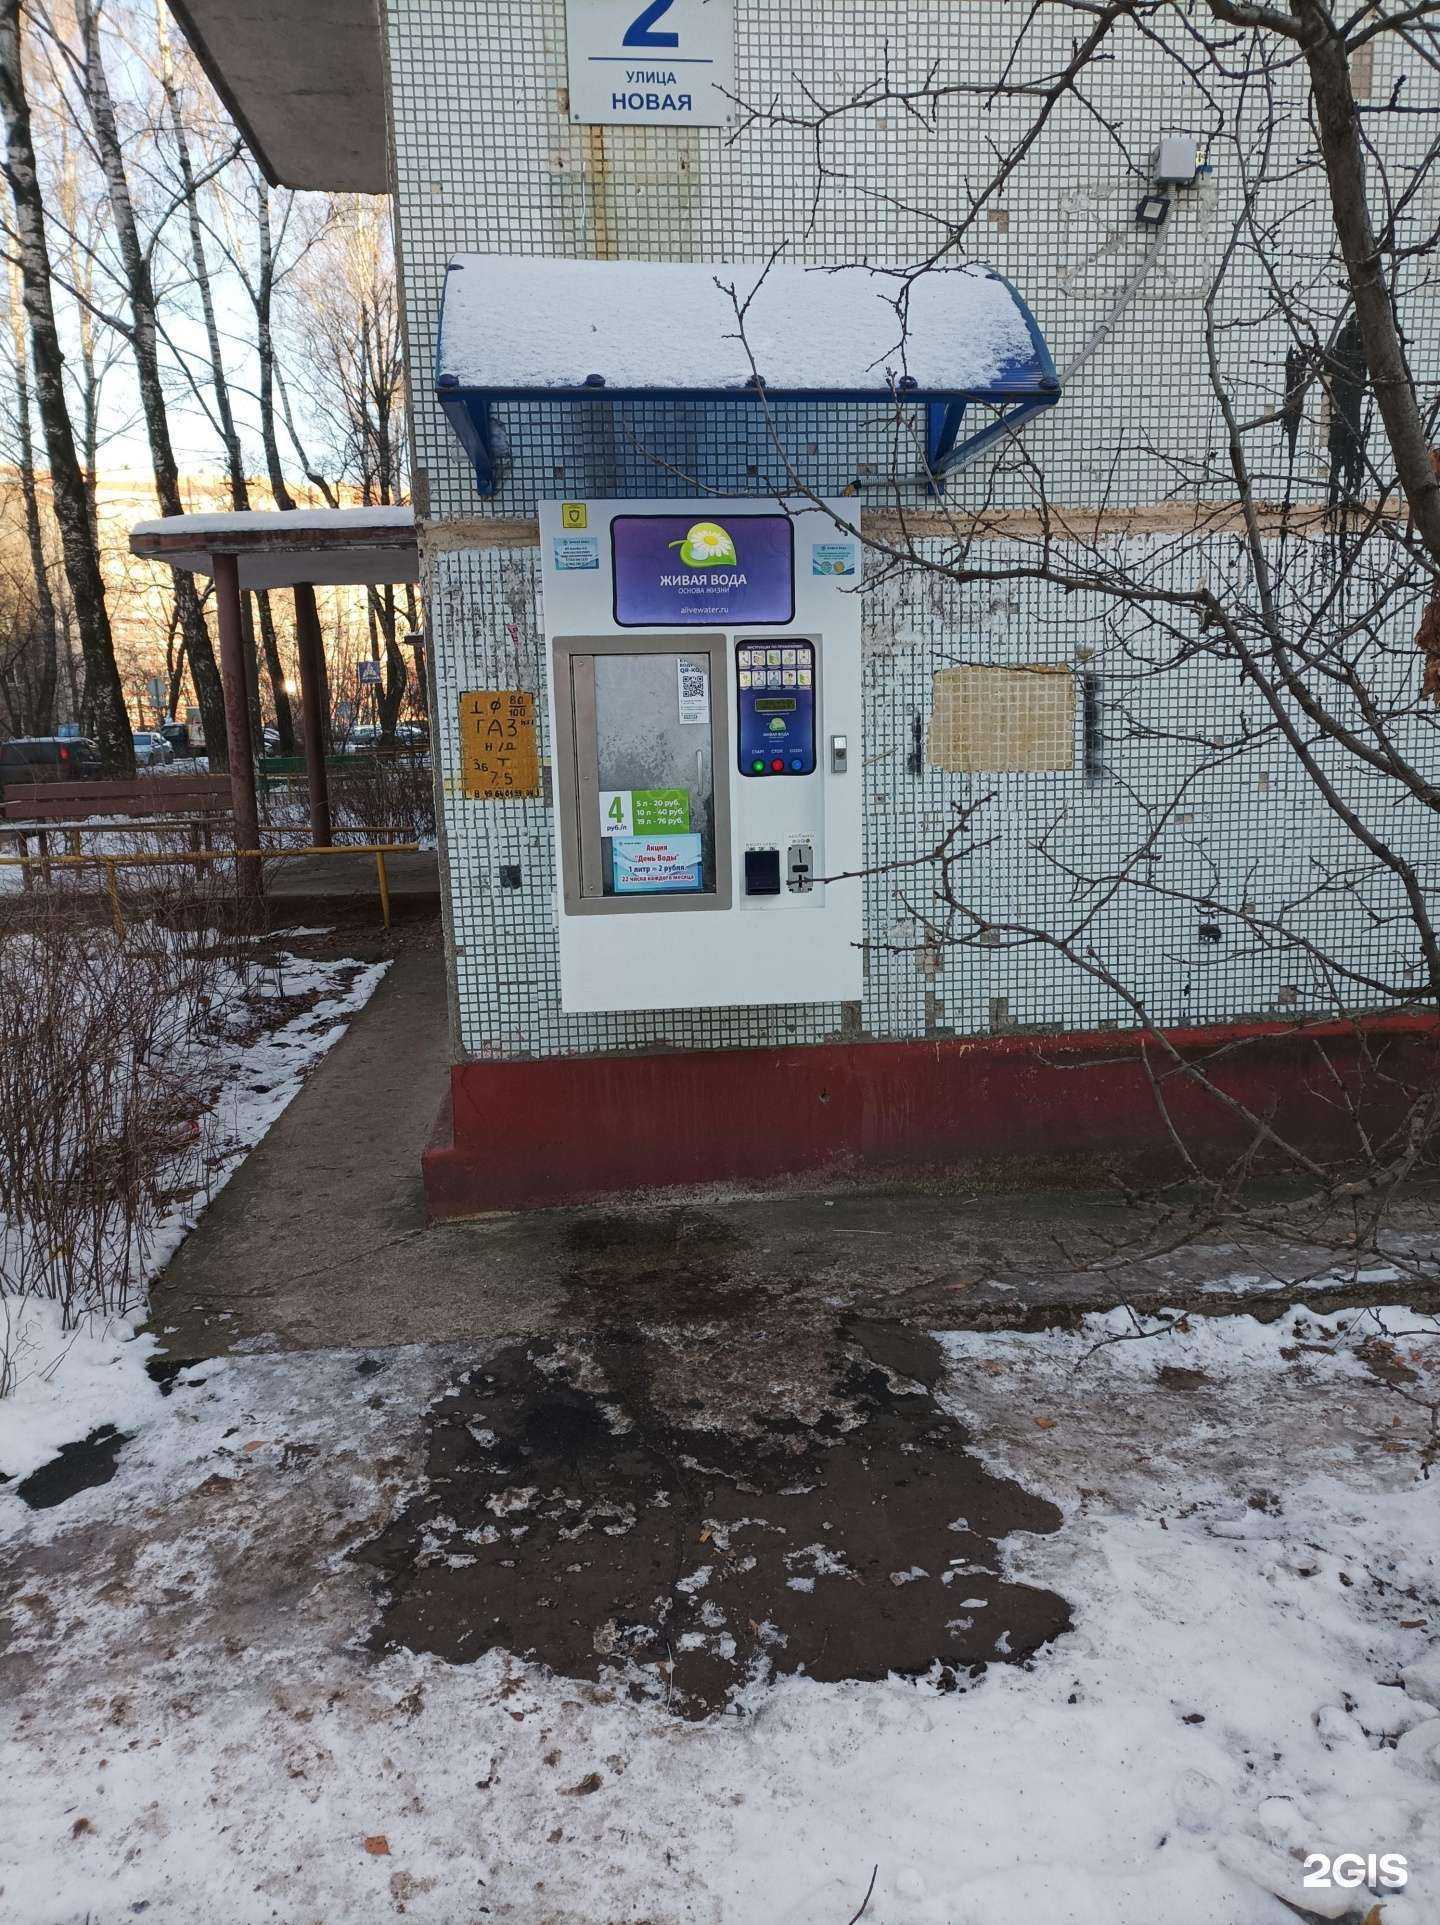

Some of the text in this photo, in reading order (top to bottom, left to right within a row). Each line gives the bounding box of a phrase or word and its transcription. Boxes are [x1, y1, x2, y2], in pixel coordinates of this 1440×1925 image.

[622, 0, 679, 47] 2
[625, 71, 677, 86] УЛИЦА
[611, 93, 692, 111] НОВАЯ
[660, 574, 748, 588] ЖИВАЯ ВОДА
[678, 587, 705, 595] ОСНОВА
[680, 606, 729, 615] alivewater.ru
[476, 719, 518, 737] ГАЗ
[664, 799, 681, 807] руб.
[608, 796, 624, 823] 4
[669, 808, 684, 816] руб.
[646, 844, 668, 852] Акция
[633, 866, 650, 874] литр
